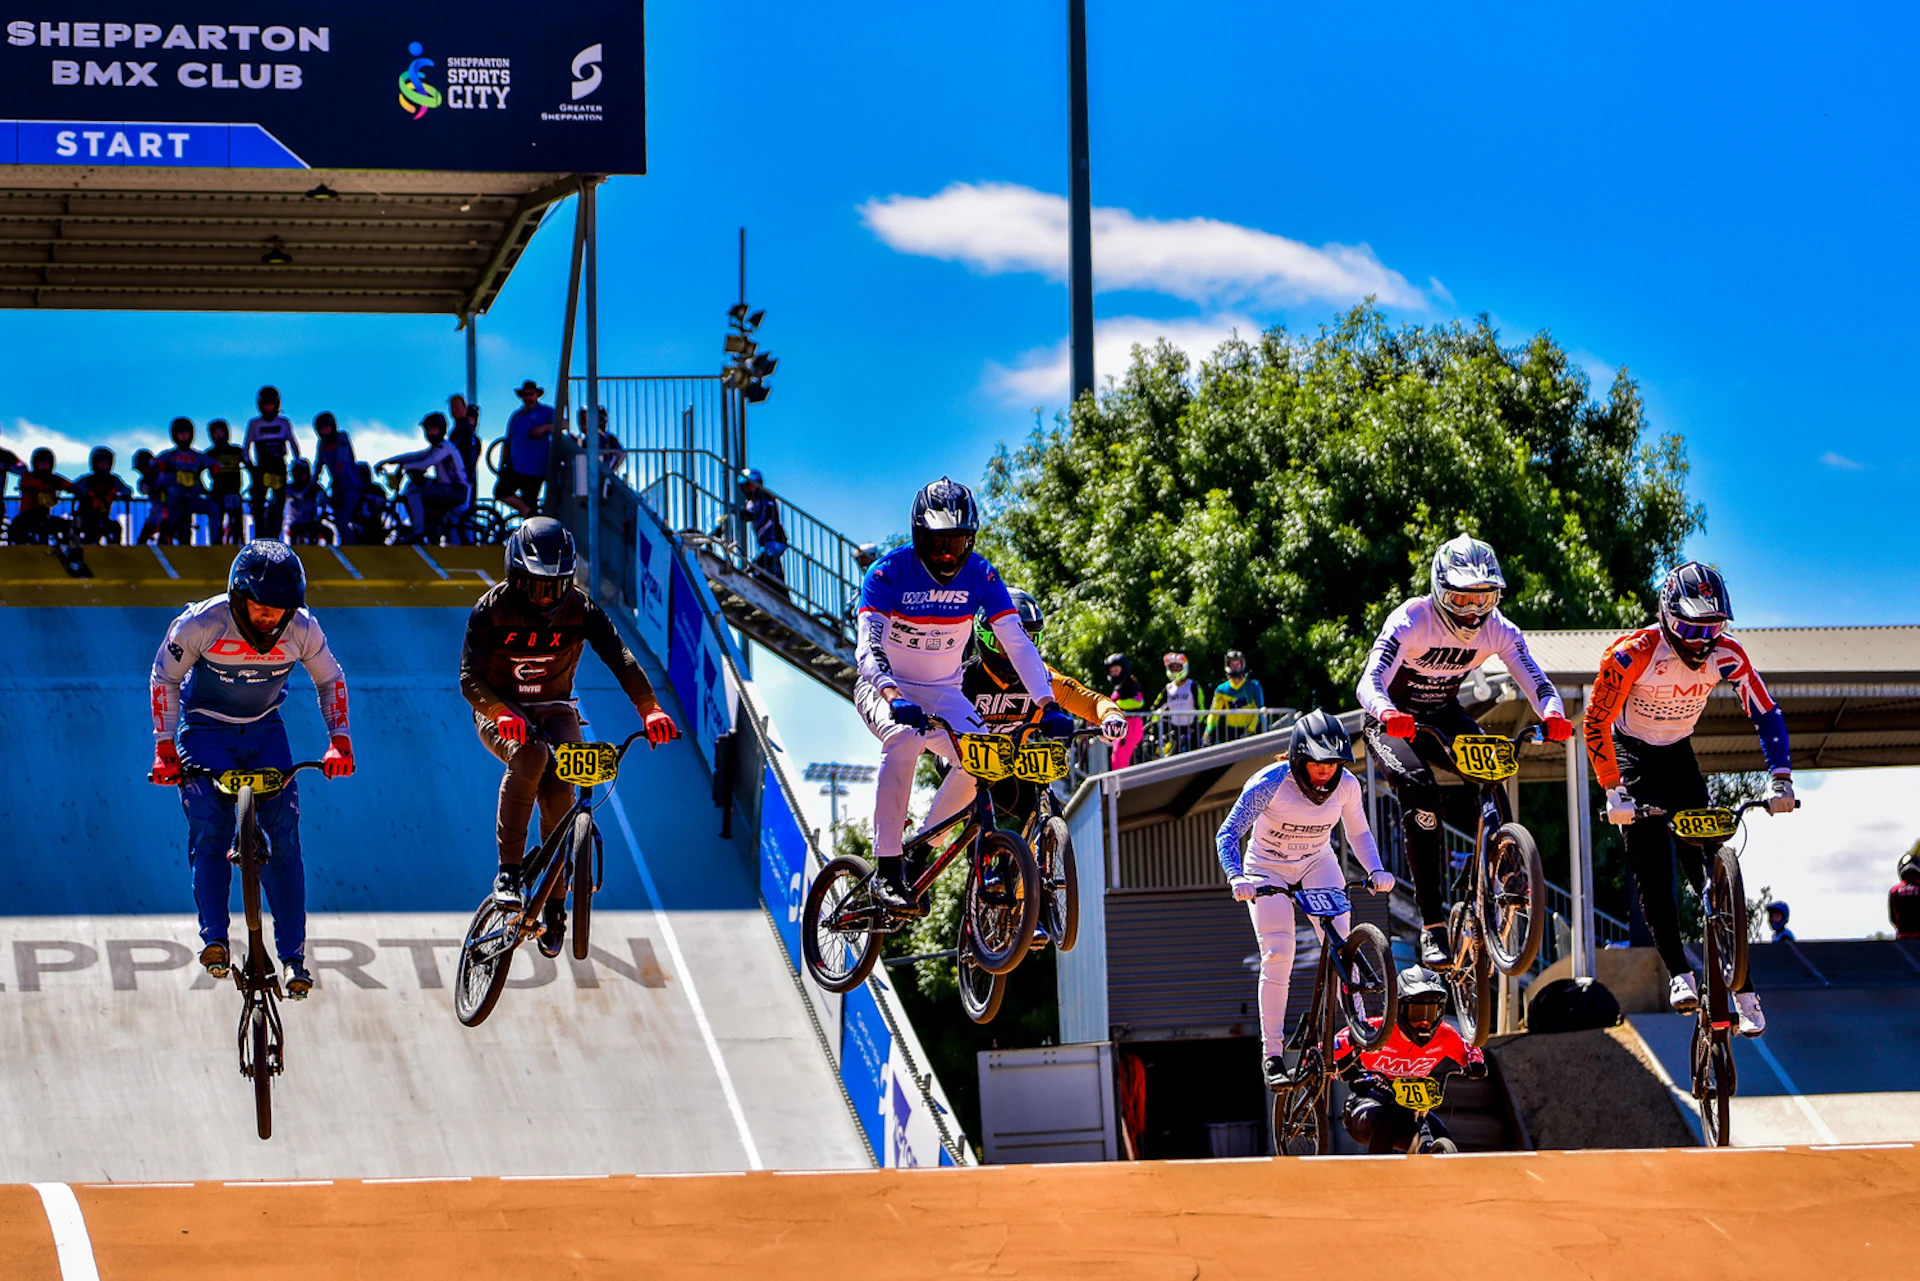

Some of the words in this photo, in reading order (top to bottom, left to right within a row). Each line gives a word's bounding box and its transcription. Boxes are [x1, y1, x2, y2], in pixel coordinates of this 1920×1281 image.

[7, 21, 329, 52] SHEPPARTON
[447, 57, 510, 68] SHEPPARTON
[52, 60, 158, 87] BMX
[177, 62, 303, 90] CLUB
[447, 69, 510, 85] SPORTS
[447, 85, 510, 109] CITY
[559, 103, 603, 112] GREATER
[541, 112, 603, 121] SHEPPARTON
[56, 131, 190, 158] START
[504, 632, 562, 647] FOX
[1637, 683, 1716, 699] REMIX
[1585, 690, 1618, 765] REMIX
[559, 751, 596, 777] 369
[968, 743, 990, 770] 97
[1016, 750, 1049, 775] 307
[1460, 745, 1497, 771] 198
[230, 776, 255, 792] 82
[1281, 823, 1331, 833] CRISP
[1680, 817, 1717, 834] 883
[1306, 894, 1332, 911] 66
[1402, 1085, 1423, 1103] 26
